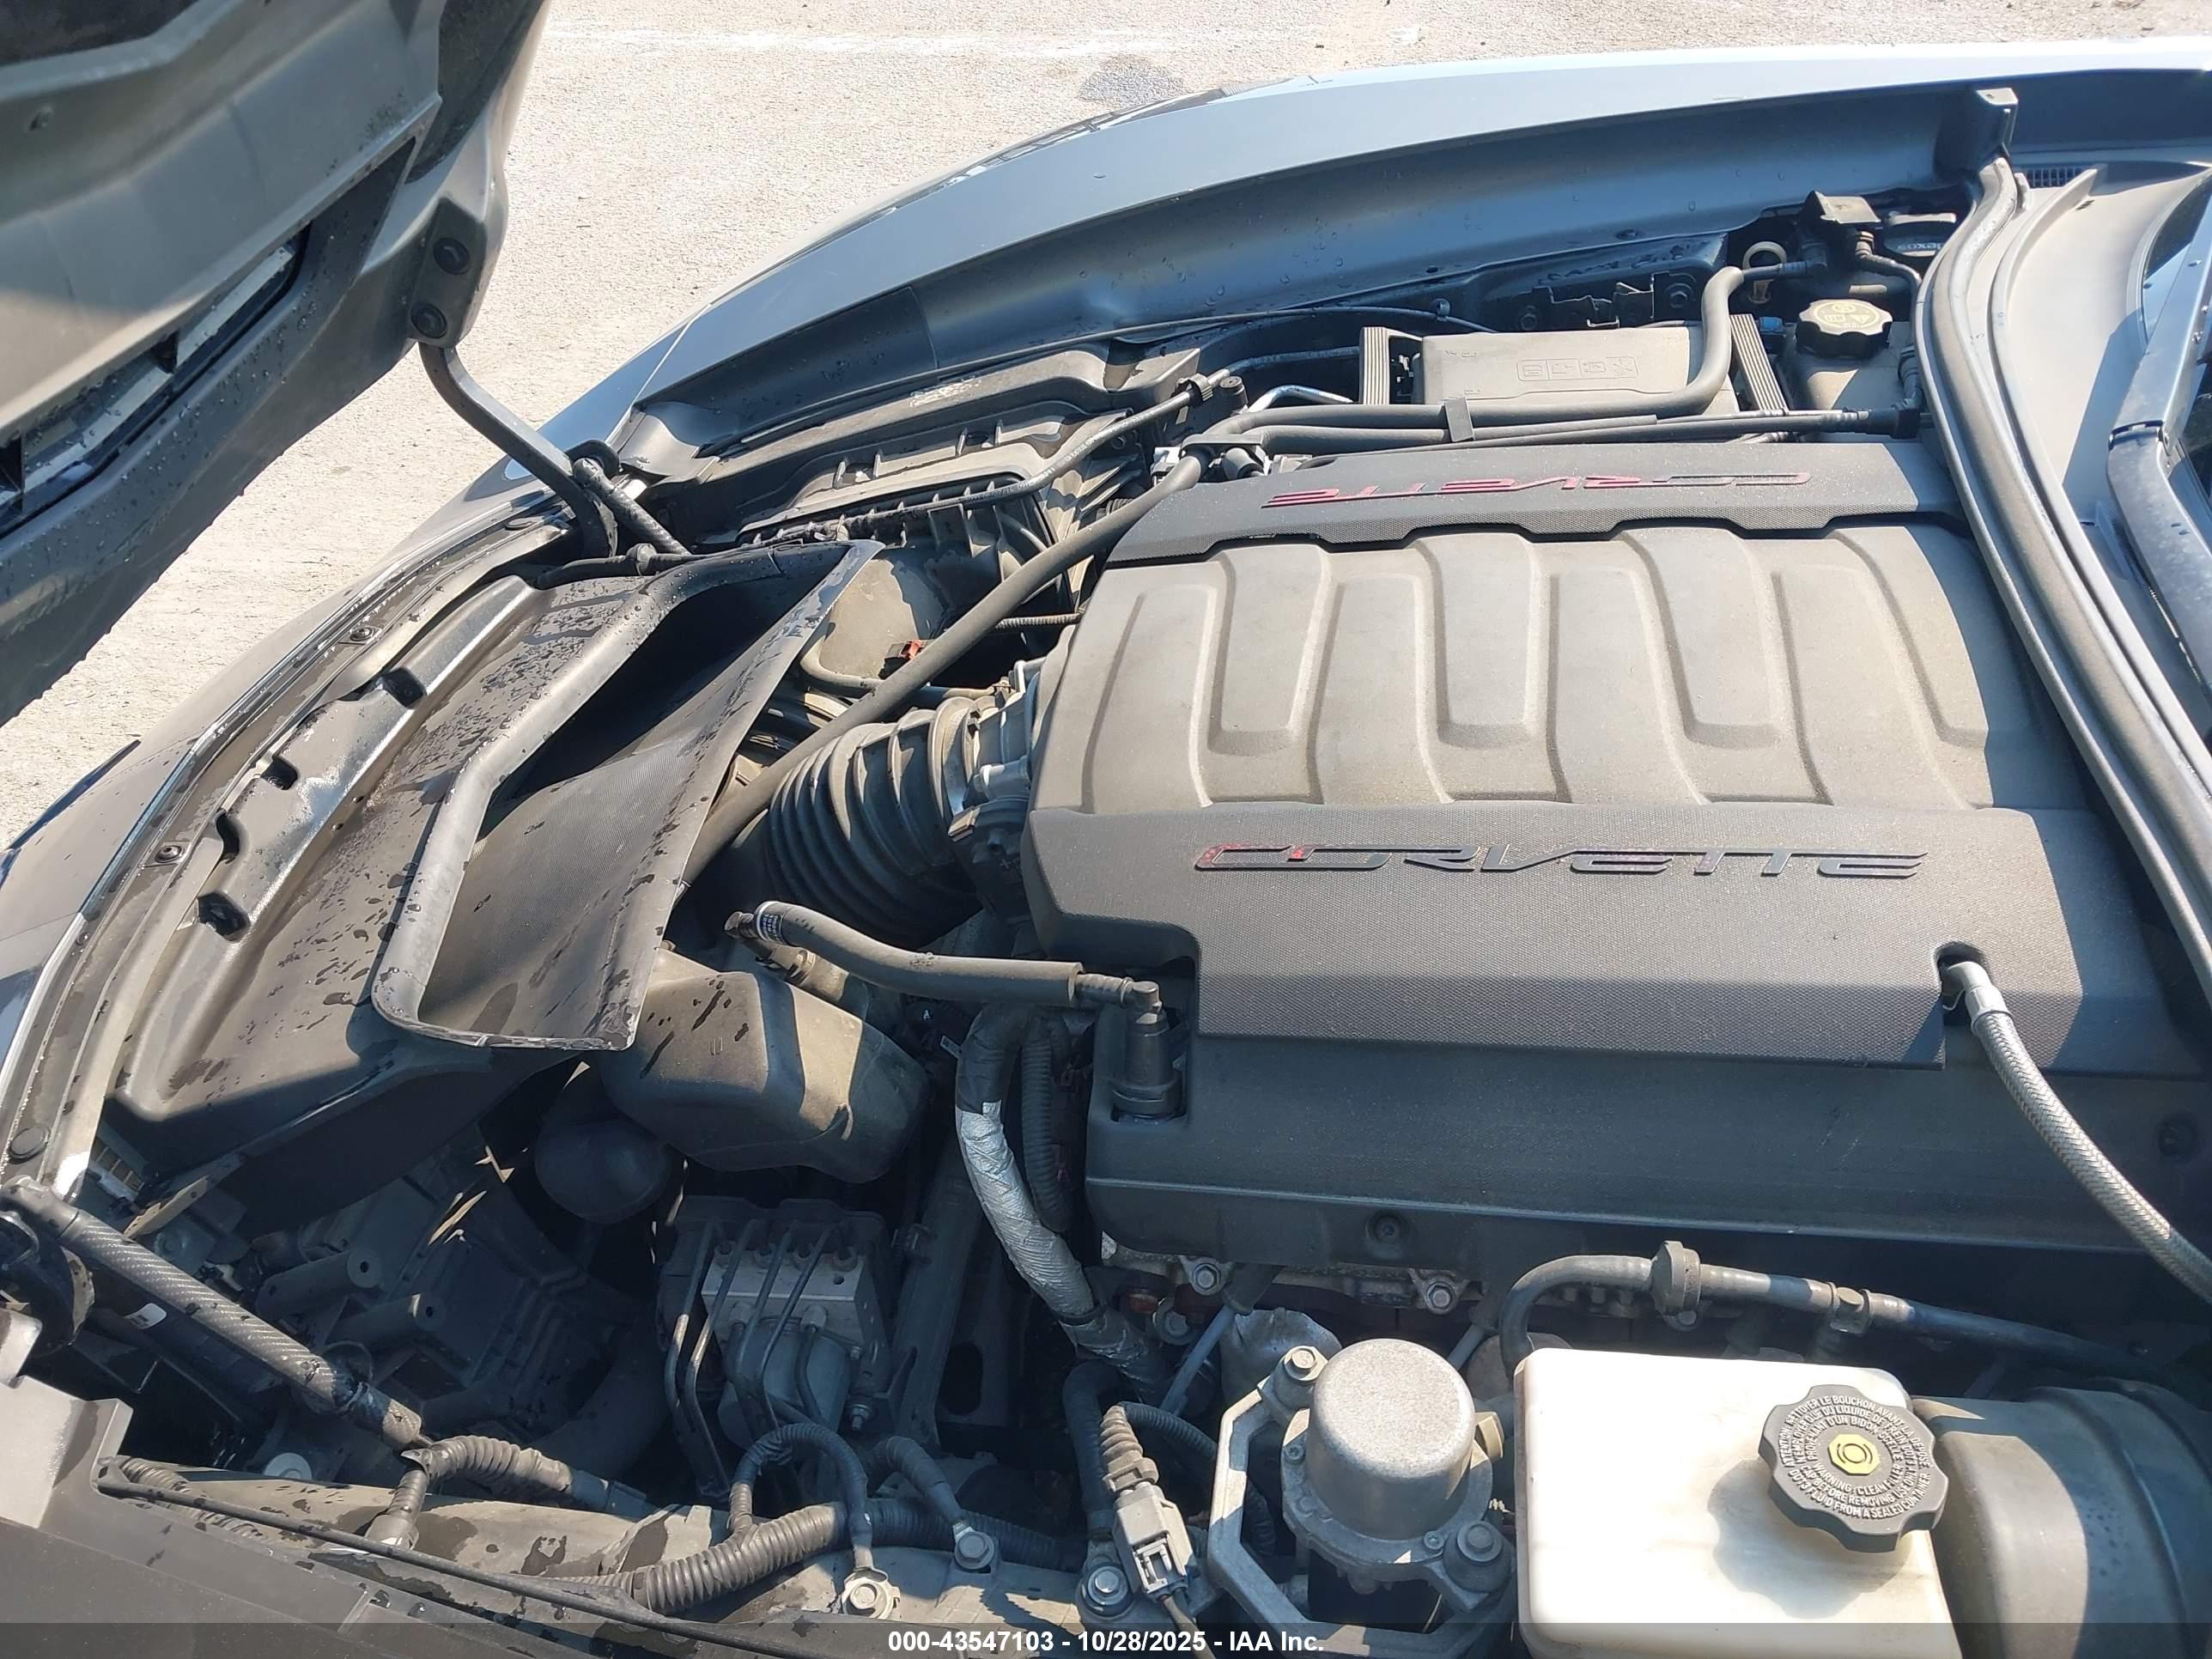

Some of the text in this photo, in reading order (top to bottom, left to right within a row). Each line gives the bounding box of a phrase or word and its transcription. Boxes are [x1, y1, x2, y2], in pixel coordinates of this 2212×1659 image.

[1261, 473, 1810, 507] CORVETTE
[1196, 845, 1929, 878] CORVETTE
[1819, 1396, 1832, 1407] LE
[1832, 1395, 1876, 1411] BOUCHON
[1876, 1407, 1905, 1426] AVANT
[1900, 1425, 1915, 1439] LA
[1820, 1406, 1835, 1417] DU
[1834, 1406, 1872, 1420] LIQUIDE
[1872, 1413, 1886, 1426] DE
[1883, 1423, 1906, 1445] FREIN
[1805, 1419, 1827, 1462] PROVENANT
[1850, 1416, 1879, 1435] BIDON
[1801, 1465, 1817, 1480] CAP
[1812, 1477, 1848, 1503] BEFORE
[1892, 1482, 1911, 1498] USE
[1904, 1467, 1917, 1487] ONLY
[1856, 1483, 1887, 1496] CLEAN
[1884, 1463, 1904, 1489] FILLER
[1806, 1486, 1833, 1508] FLUID
[1832, 1502, 1862, 1518] FROM
[1862, 1508, 1871, 1519] A
[1870, 1503, 1904, 1519] SEALED
